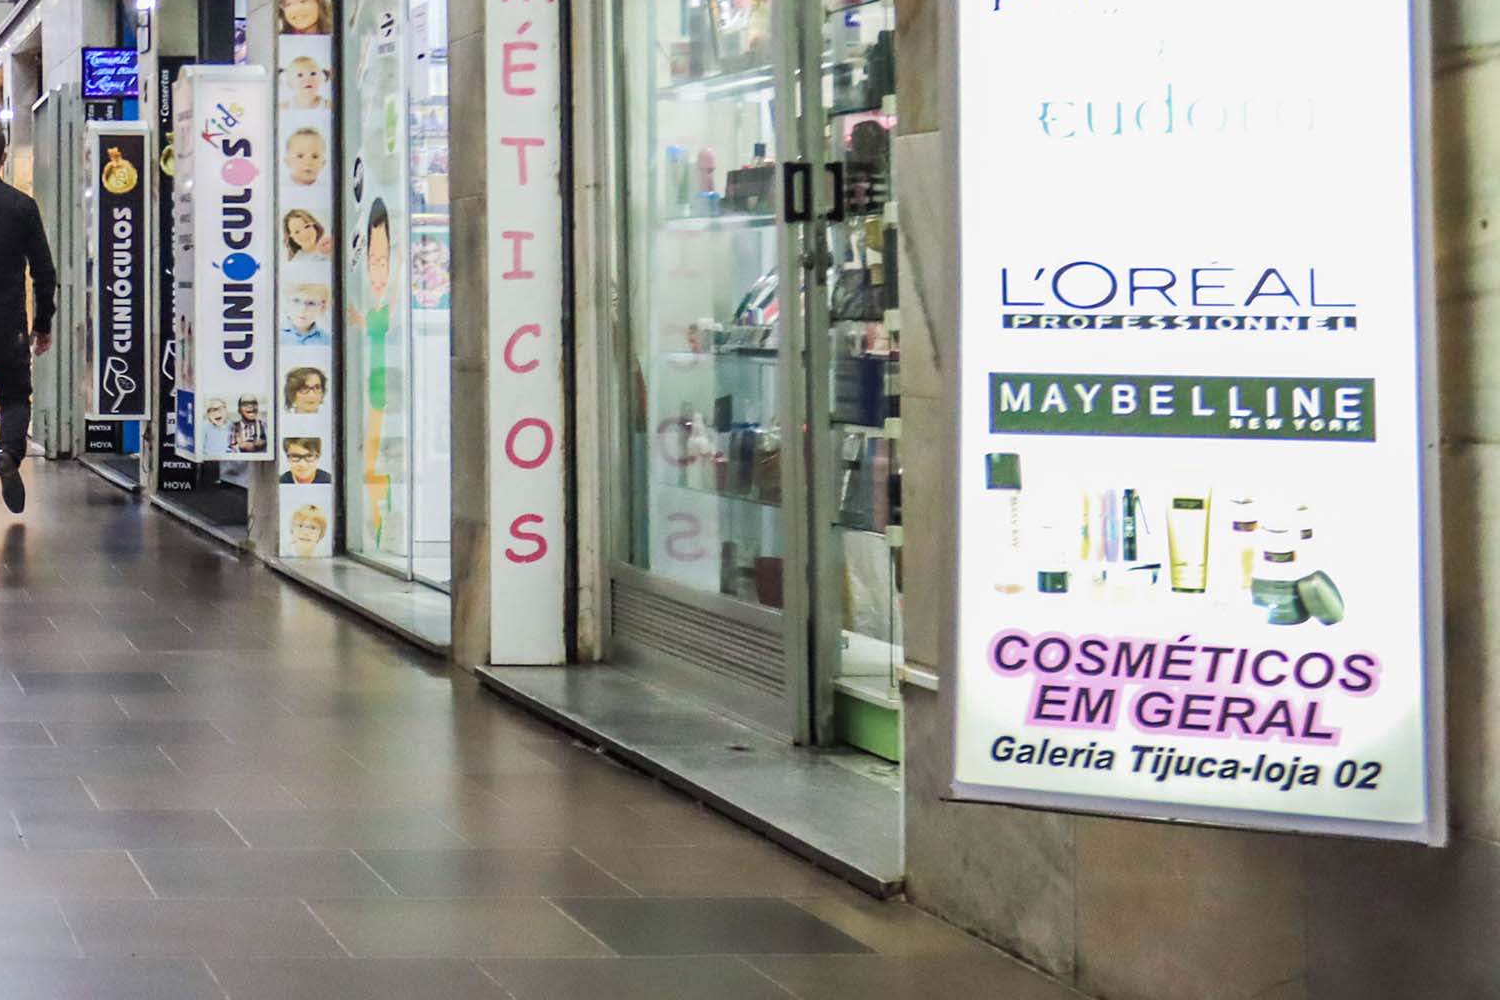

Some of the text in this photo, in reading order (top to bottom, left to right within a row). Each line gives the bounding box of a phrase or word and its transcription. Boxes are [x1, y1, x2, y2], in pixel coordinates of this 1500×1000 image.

[161, 69, 170, 117] Consertos
[201, 101, 246, 149] Kids
[212, 138, 259, 371] CLINIÓCULOS
[107, 206, 132, 353] CLINIÓCULOS
[1011, 315, 1354, 331] PROFESSIONNEL
[1000, 382, 1362, 420] MAYBELLINE
[90, 441, 113, 449] HOYA
[1230, 418, 1363, 433] NEW YORK
[163, 461, 192, 469] PENTAX
[164, 481, 191, 490] HOYA
[994, 634, 1375, 692] COSMÉTICOS
[1034, 684, 1334, 740] EM GERAL
[990, 735, 1382, 792] Galeria Tijuca-loja 02
